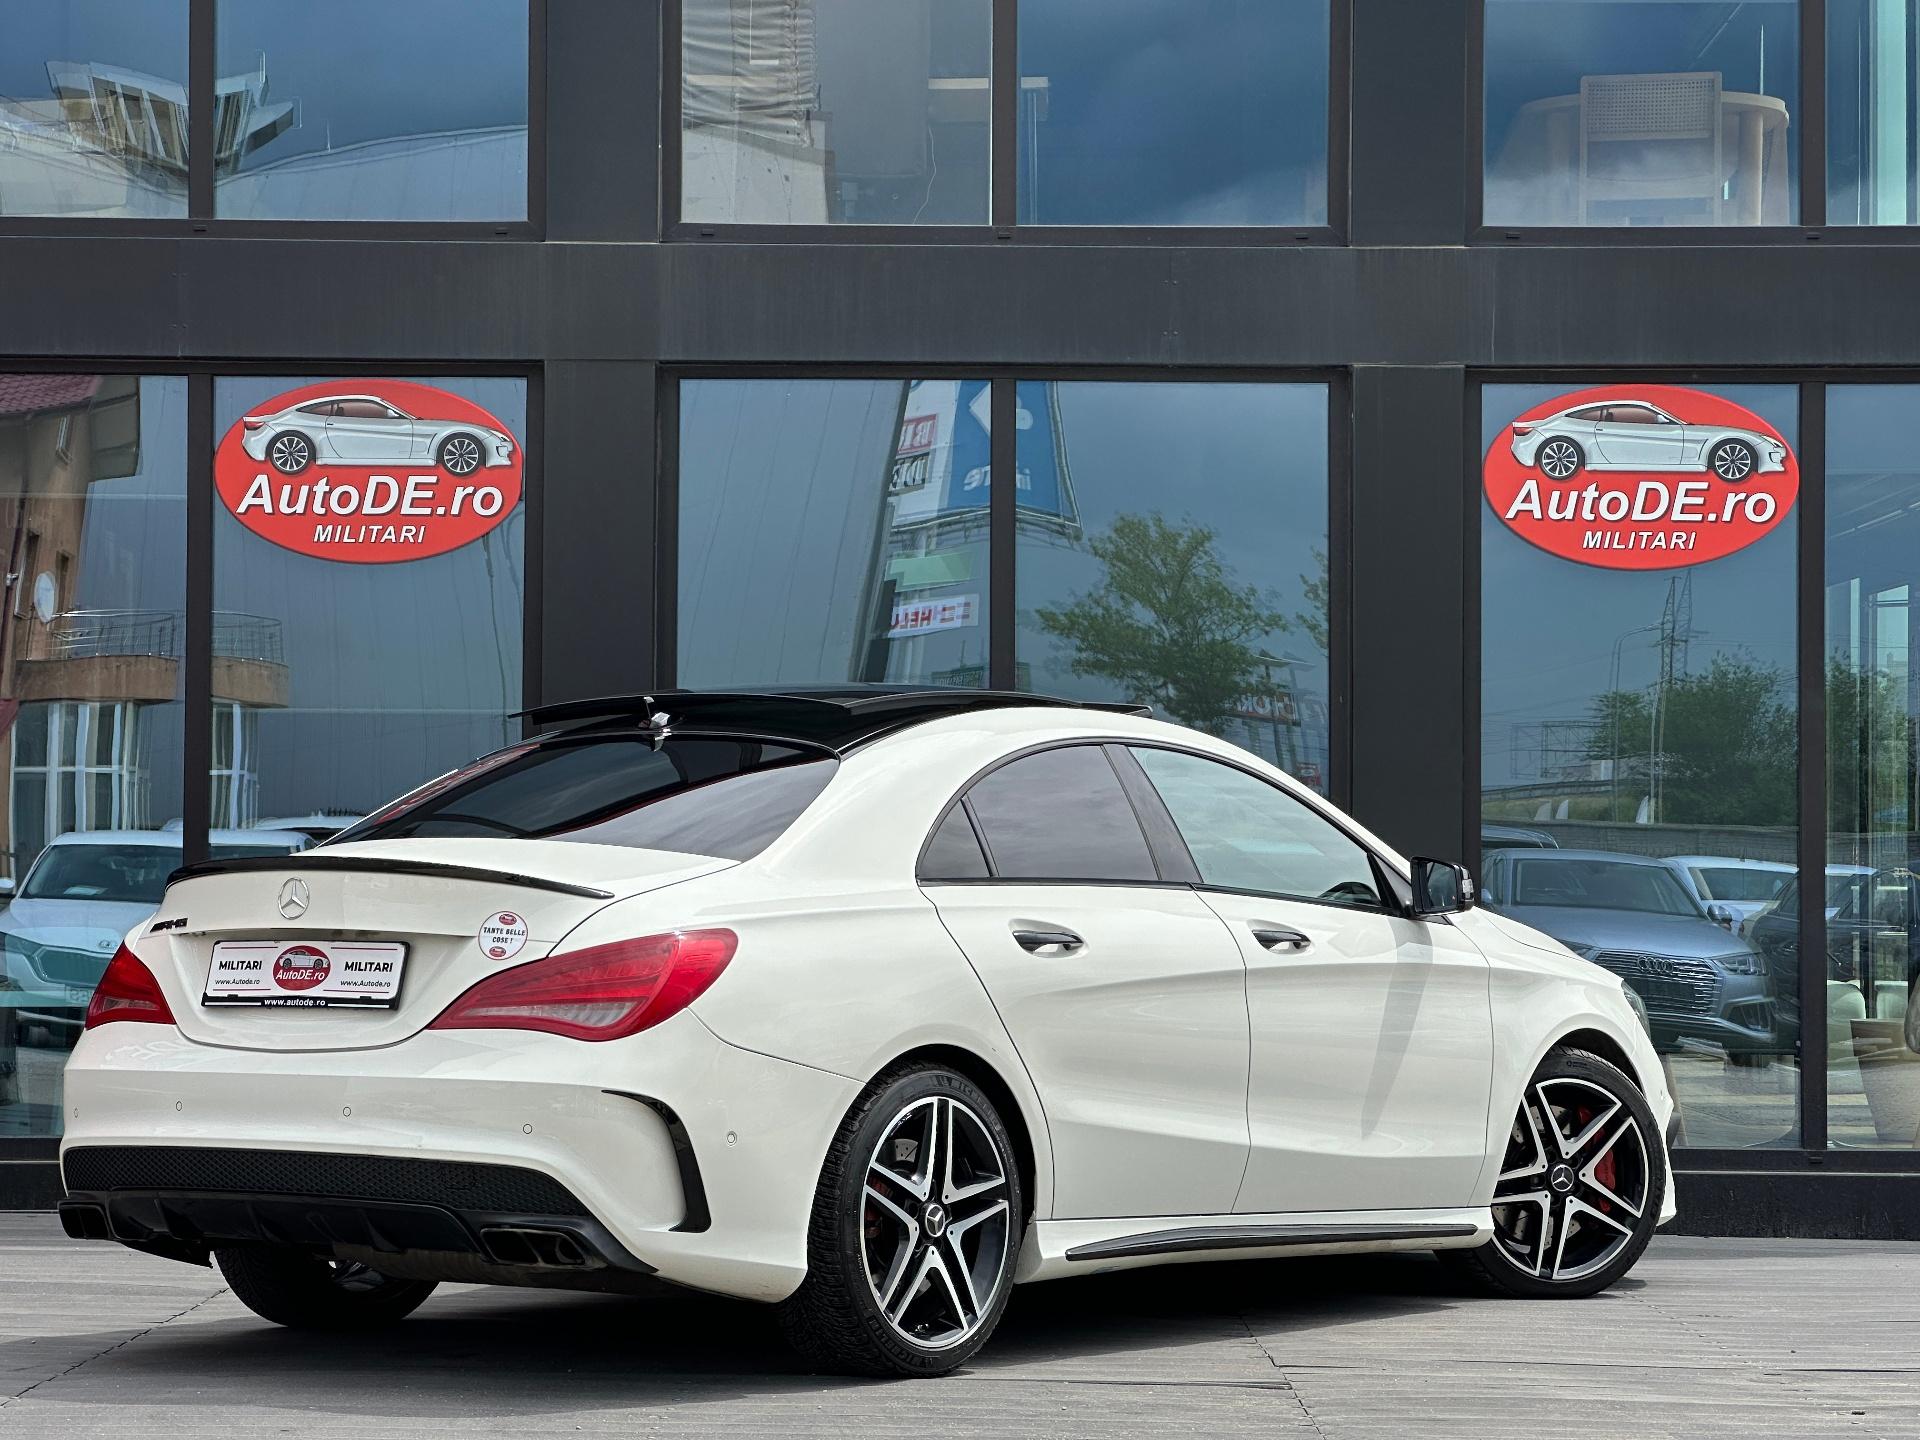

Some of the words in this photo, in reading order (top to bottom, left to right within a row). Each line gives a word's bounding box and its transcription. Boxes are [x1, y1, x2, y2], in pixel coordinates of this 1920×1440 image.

[236, 474, 504, 517] AutoDE.ro
[1505, 479, 1777, 524] AutoDE.ro
[313, 525, 426, 544] MILITARI
[1582, 531, 1696, 551] MILITARI
[483, 927, 504, 935] TANTE
[505, 928, 526, 937] BELLE
[492, 936, 509, 944] COSE
[218, 960, 263, 971] MILITARI
[344, 961, 394, 973] MILITARI
[275, 969, 325, 981] AutoDE.ro
[340, 980, 391, 988] www.Autode.ro
[264, 998, 326, 1006] www.autode.ro
